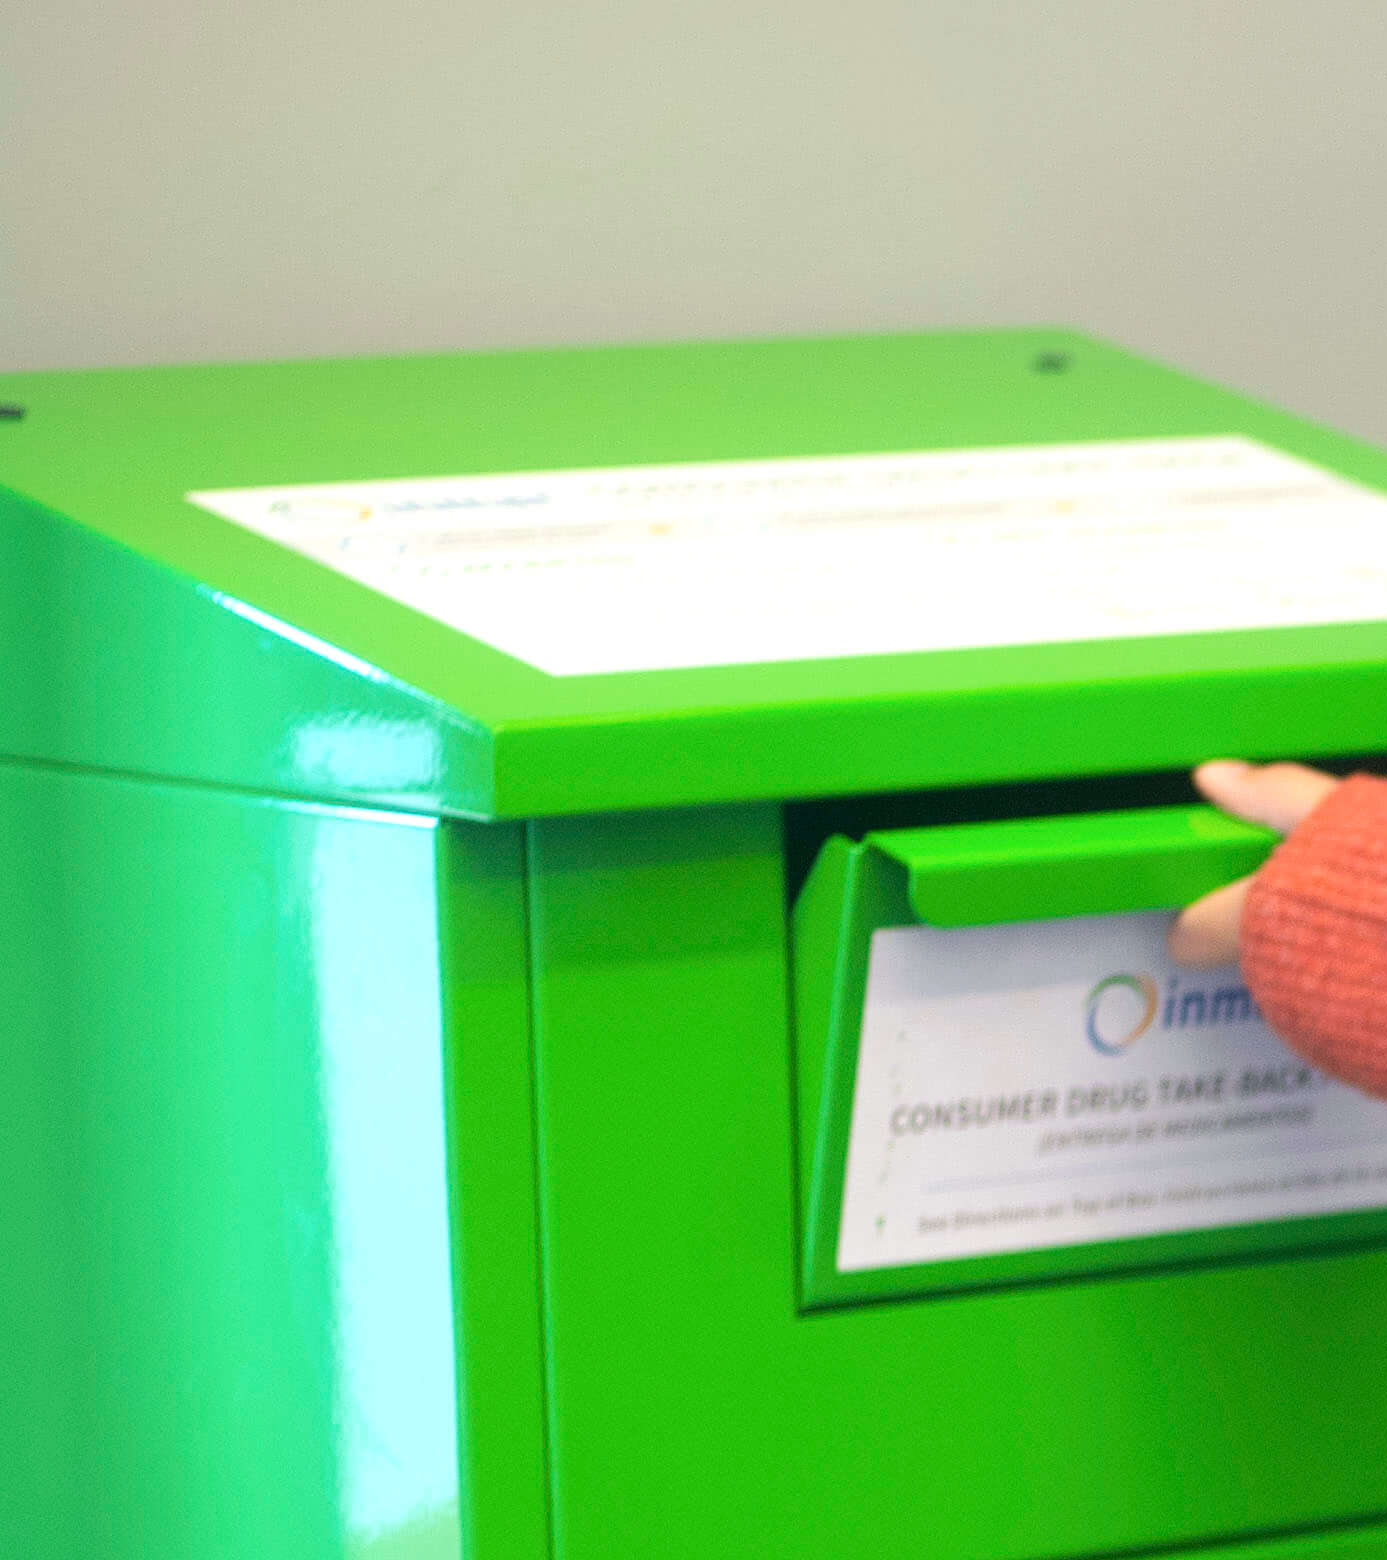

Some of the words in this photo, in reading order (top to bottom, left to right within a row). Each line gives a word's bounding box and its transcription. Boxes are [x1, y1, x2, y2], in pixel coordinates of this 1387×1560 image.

[1162, 974, 1266, 1029] inm
[889, 1089, 1058, 1135] CONSUMER
[1065, 1079, 1148, 1117] DRUG
[1158, 1071, 1225, 1108] TAKE
